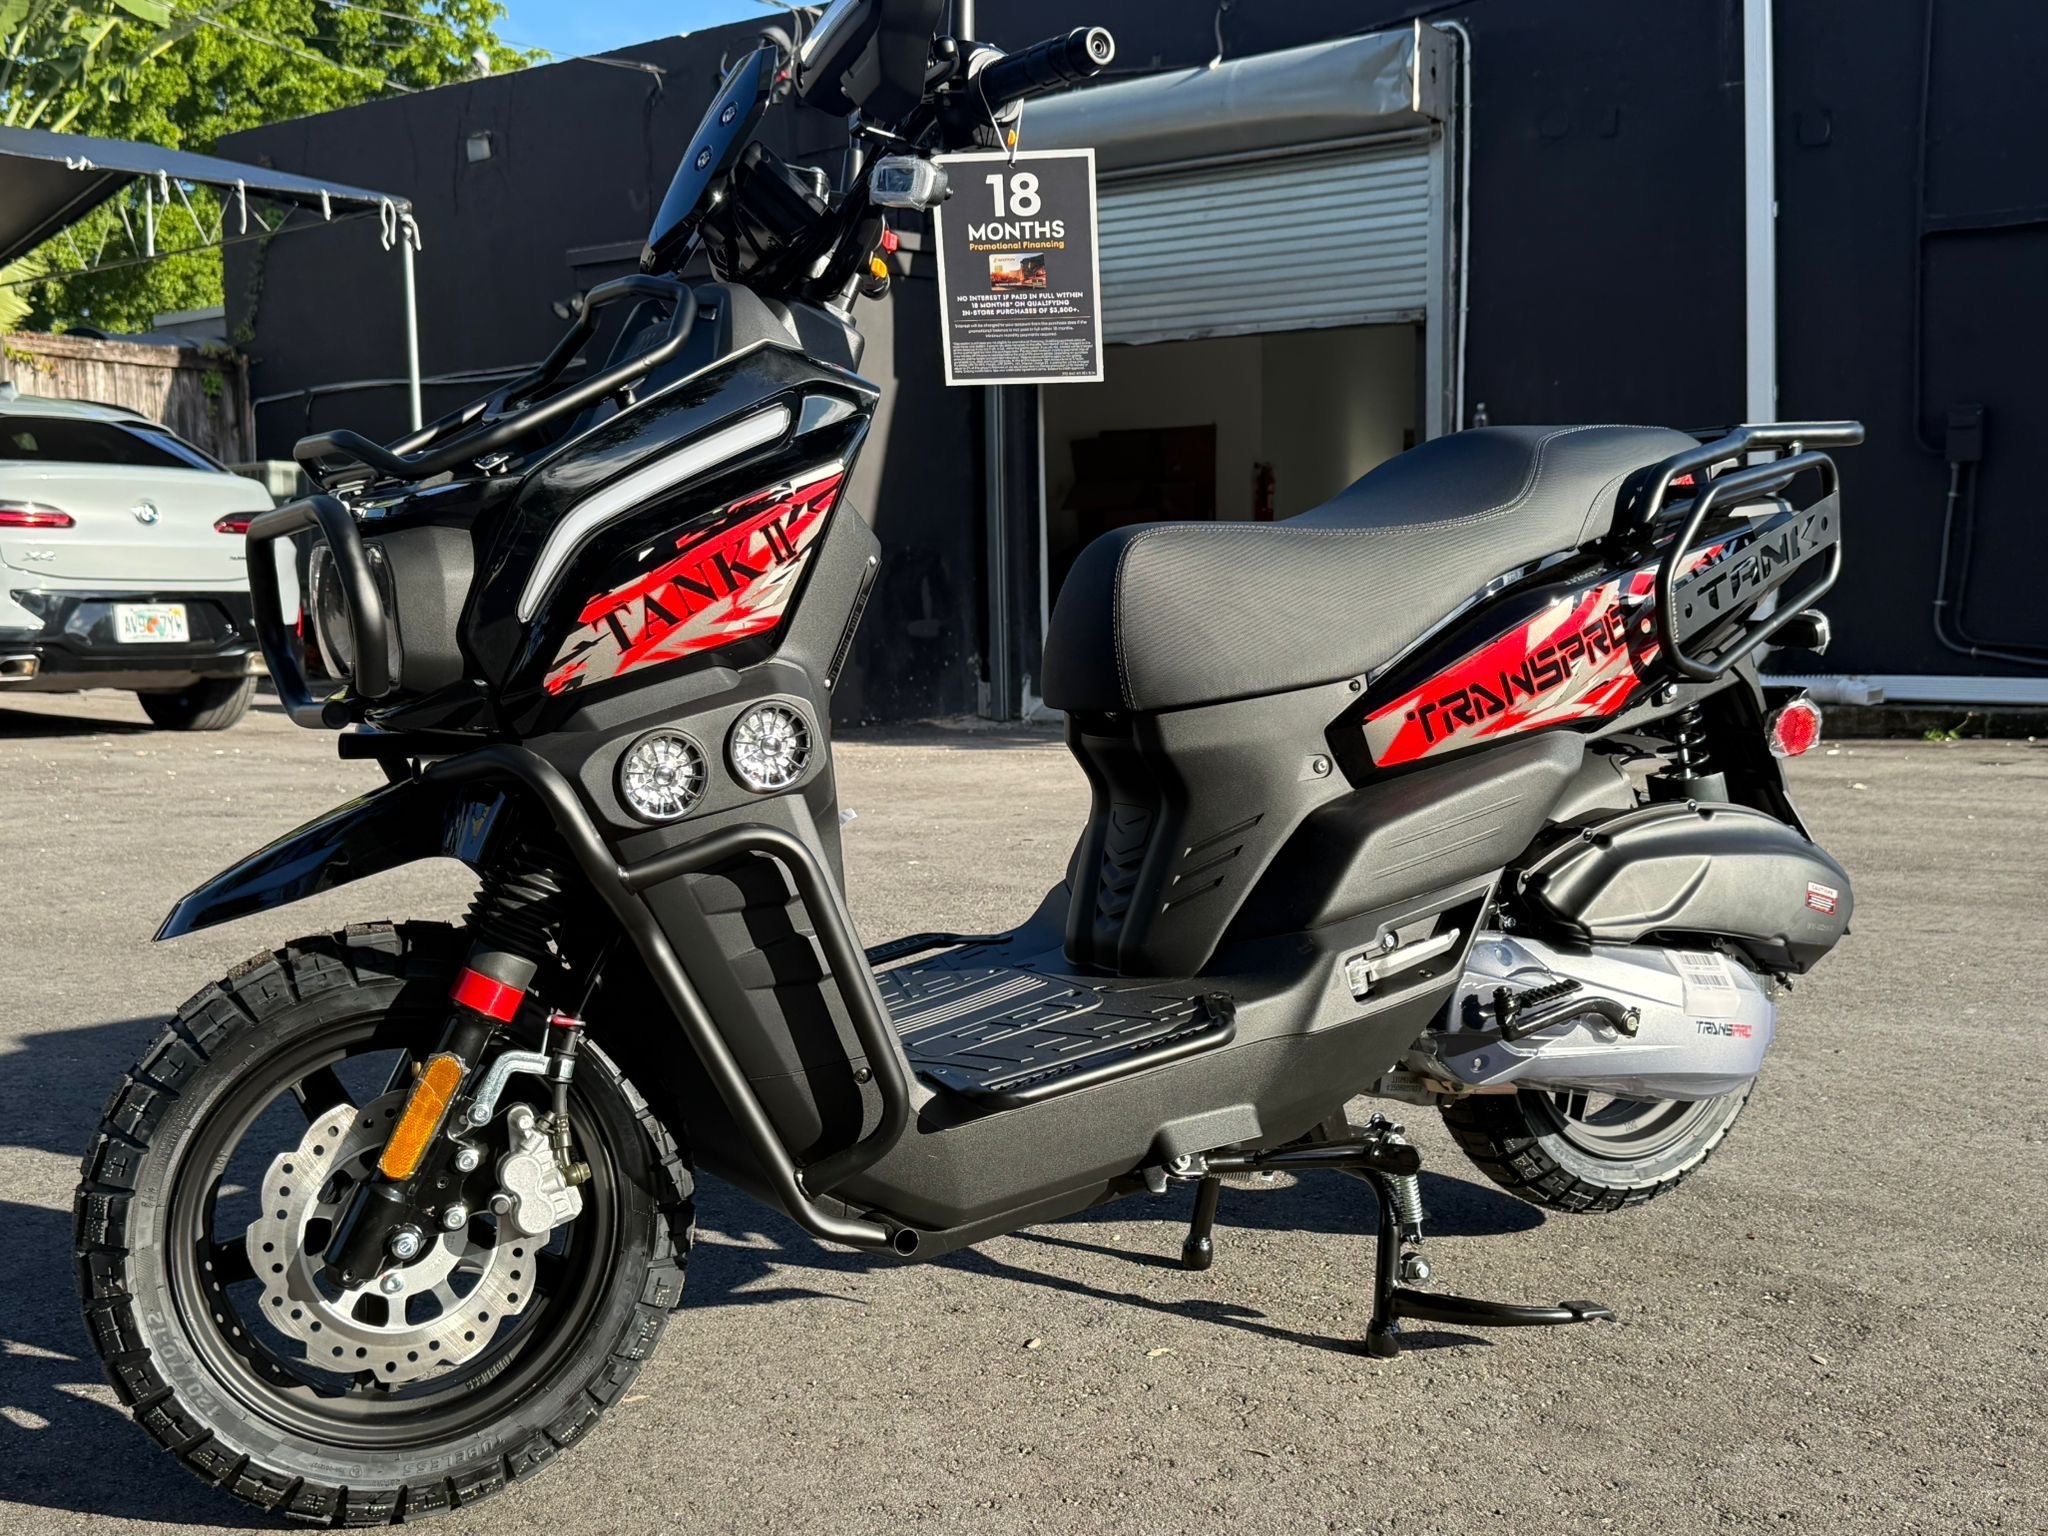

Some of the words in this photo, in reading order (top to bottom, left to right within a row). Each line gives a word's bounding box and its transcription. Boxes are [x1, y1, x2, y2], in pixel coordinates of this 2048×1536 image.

[985, 172, 1042, 217] 18
[967, 220, 1065, 241] MONTHS
[969, 242, 1021, 251] Promotional
[1022, 240, 1065, 249] Financing
[969, 294, 1001, 302] INTEREST
[1002, 293, 1010, 301] IF
[1056, 291, 1083, 299] WITHIN
[1014, 300, 1025, 308] ON
[1027, 299, 1070, 307] QUALIFYING
[962, 308, 995, 316] IN-STORE
[996, 307, 1037, 315] PURCHASES
[1038, 306, 1048, 314] OF
[1697, 514, 1819, 610] TANK
[591, 536, 768, 656] TANK
[758, 516, 802, 568] II
[1695, 1020, 1752, 1038] TRANSPRO
[147, 1311, 219, 1416] 120/70-12
[402, 1434, 507, 1477] TUBELESS
